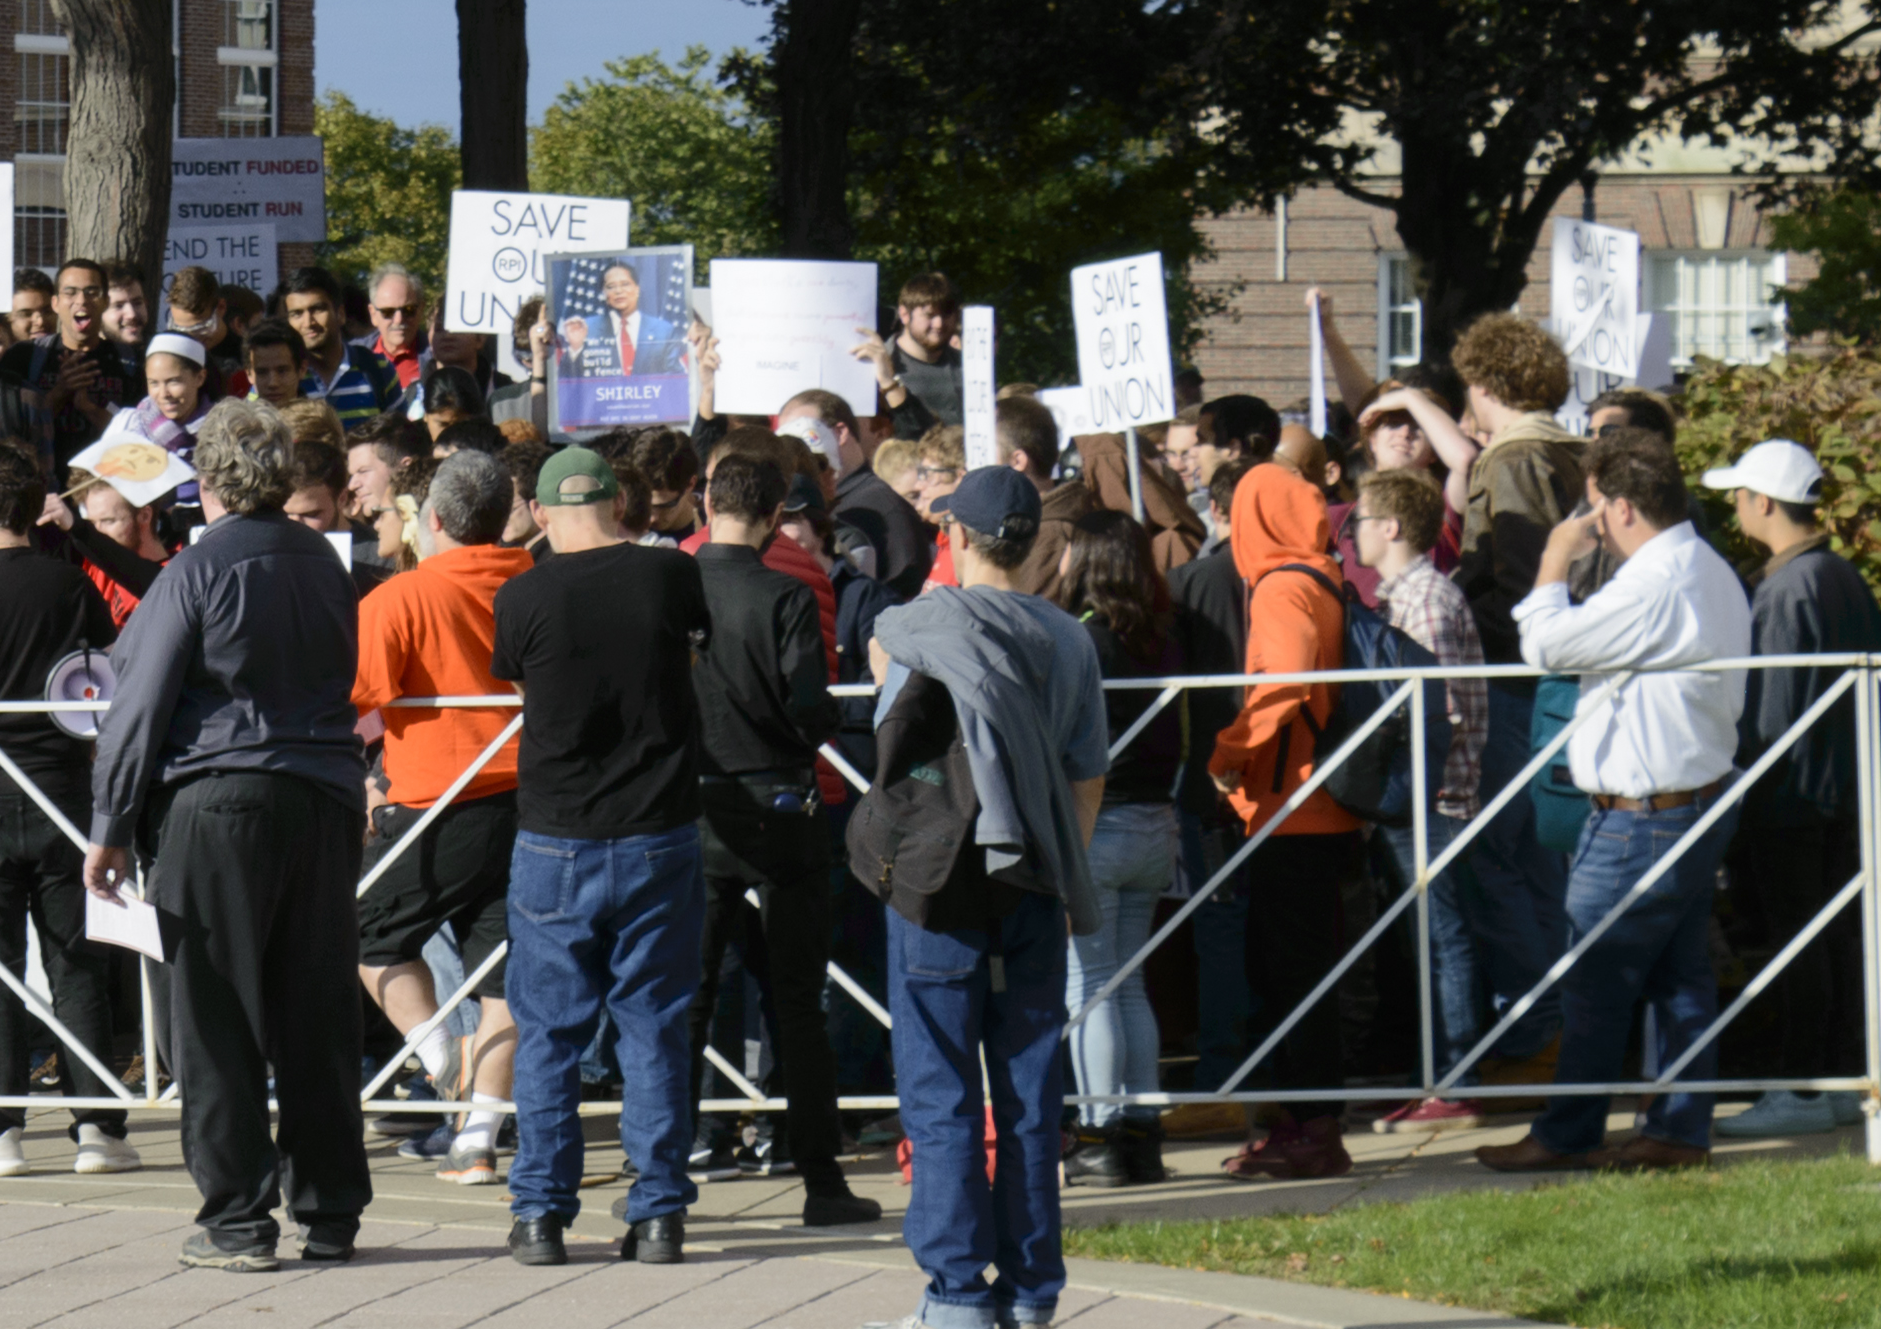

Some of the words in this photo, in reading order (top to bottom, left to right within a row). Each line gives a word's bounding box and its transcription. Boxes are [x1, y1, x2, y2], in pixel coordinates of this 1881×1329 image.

[172, 161, 241, 176] TUDENT
[246, 160, 318, 175] FUNDED
[178, 202, 260, 218] STUDENT
[265, 202, 303, 216] RUN
[491, 200, 588, 240] SAVE
[164, 238, 208, 261] END
[216, 236, 260, 258] THE
[1572, 227, 1617, 273] SAVE
[1092, 265, 1141, 316] SAVE
[583, 349, 611, 358] gonna
[583, 358, 612, 367] build
[756, 360, 800, 372] IMAGINE
[596, 385, 662, 401] SHIRLEY
[1089, 373, 1165, 427] UNION
